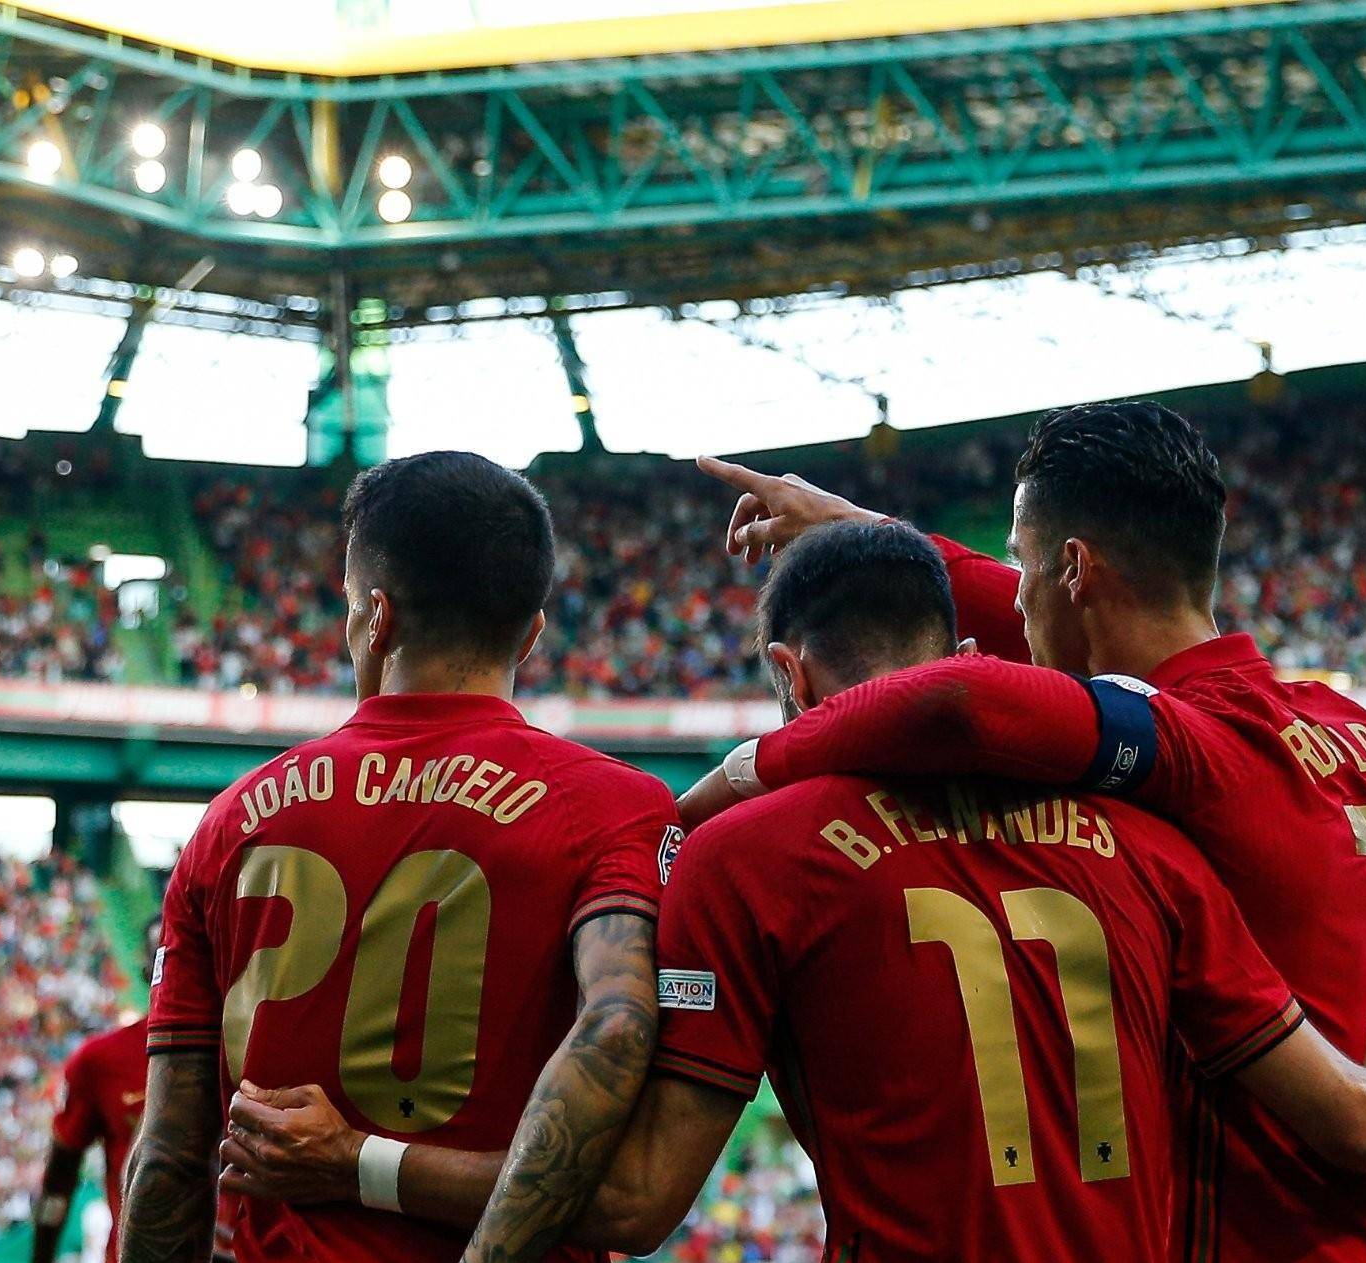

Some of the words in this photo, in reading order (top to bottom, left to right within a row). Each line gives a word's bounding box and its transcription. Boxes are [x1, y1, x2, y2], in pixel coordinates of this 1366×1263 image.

[240, 755, 333, 834] JOÃO
[356, 753, 547, 824] CANCELO
[223, 846, 491, 1133] 20
[904, 887, 1131, 1186] 11
